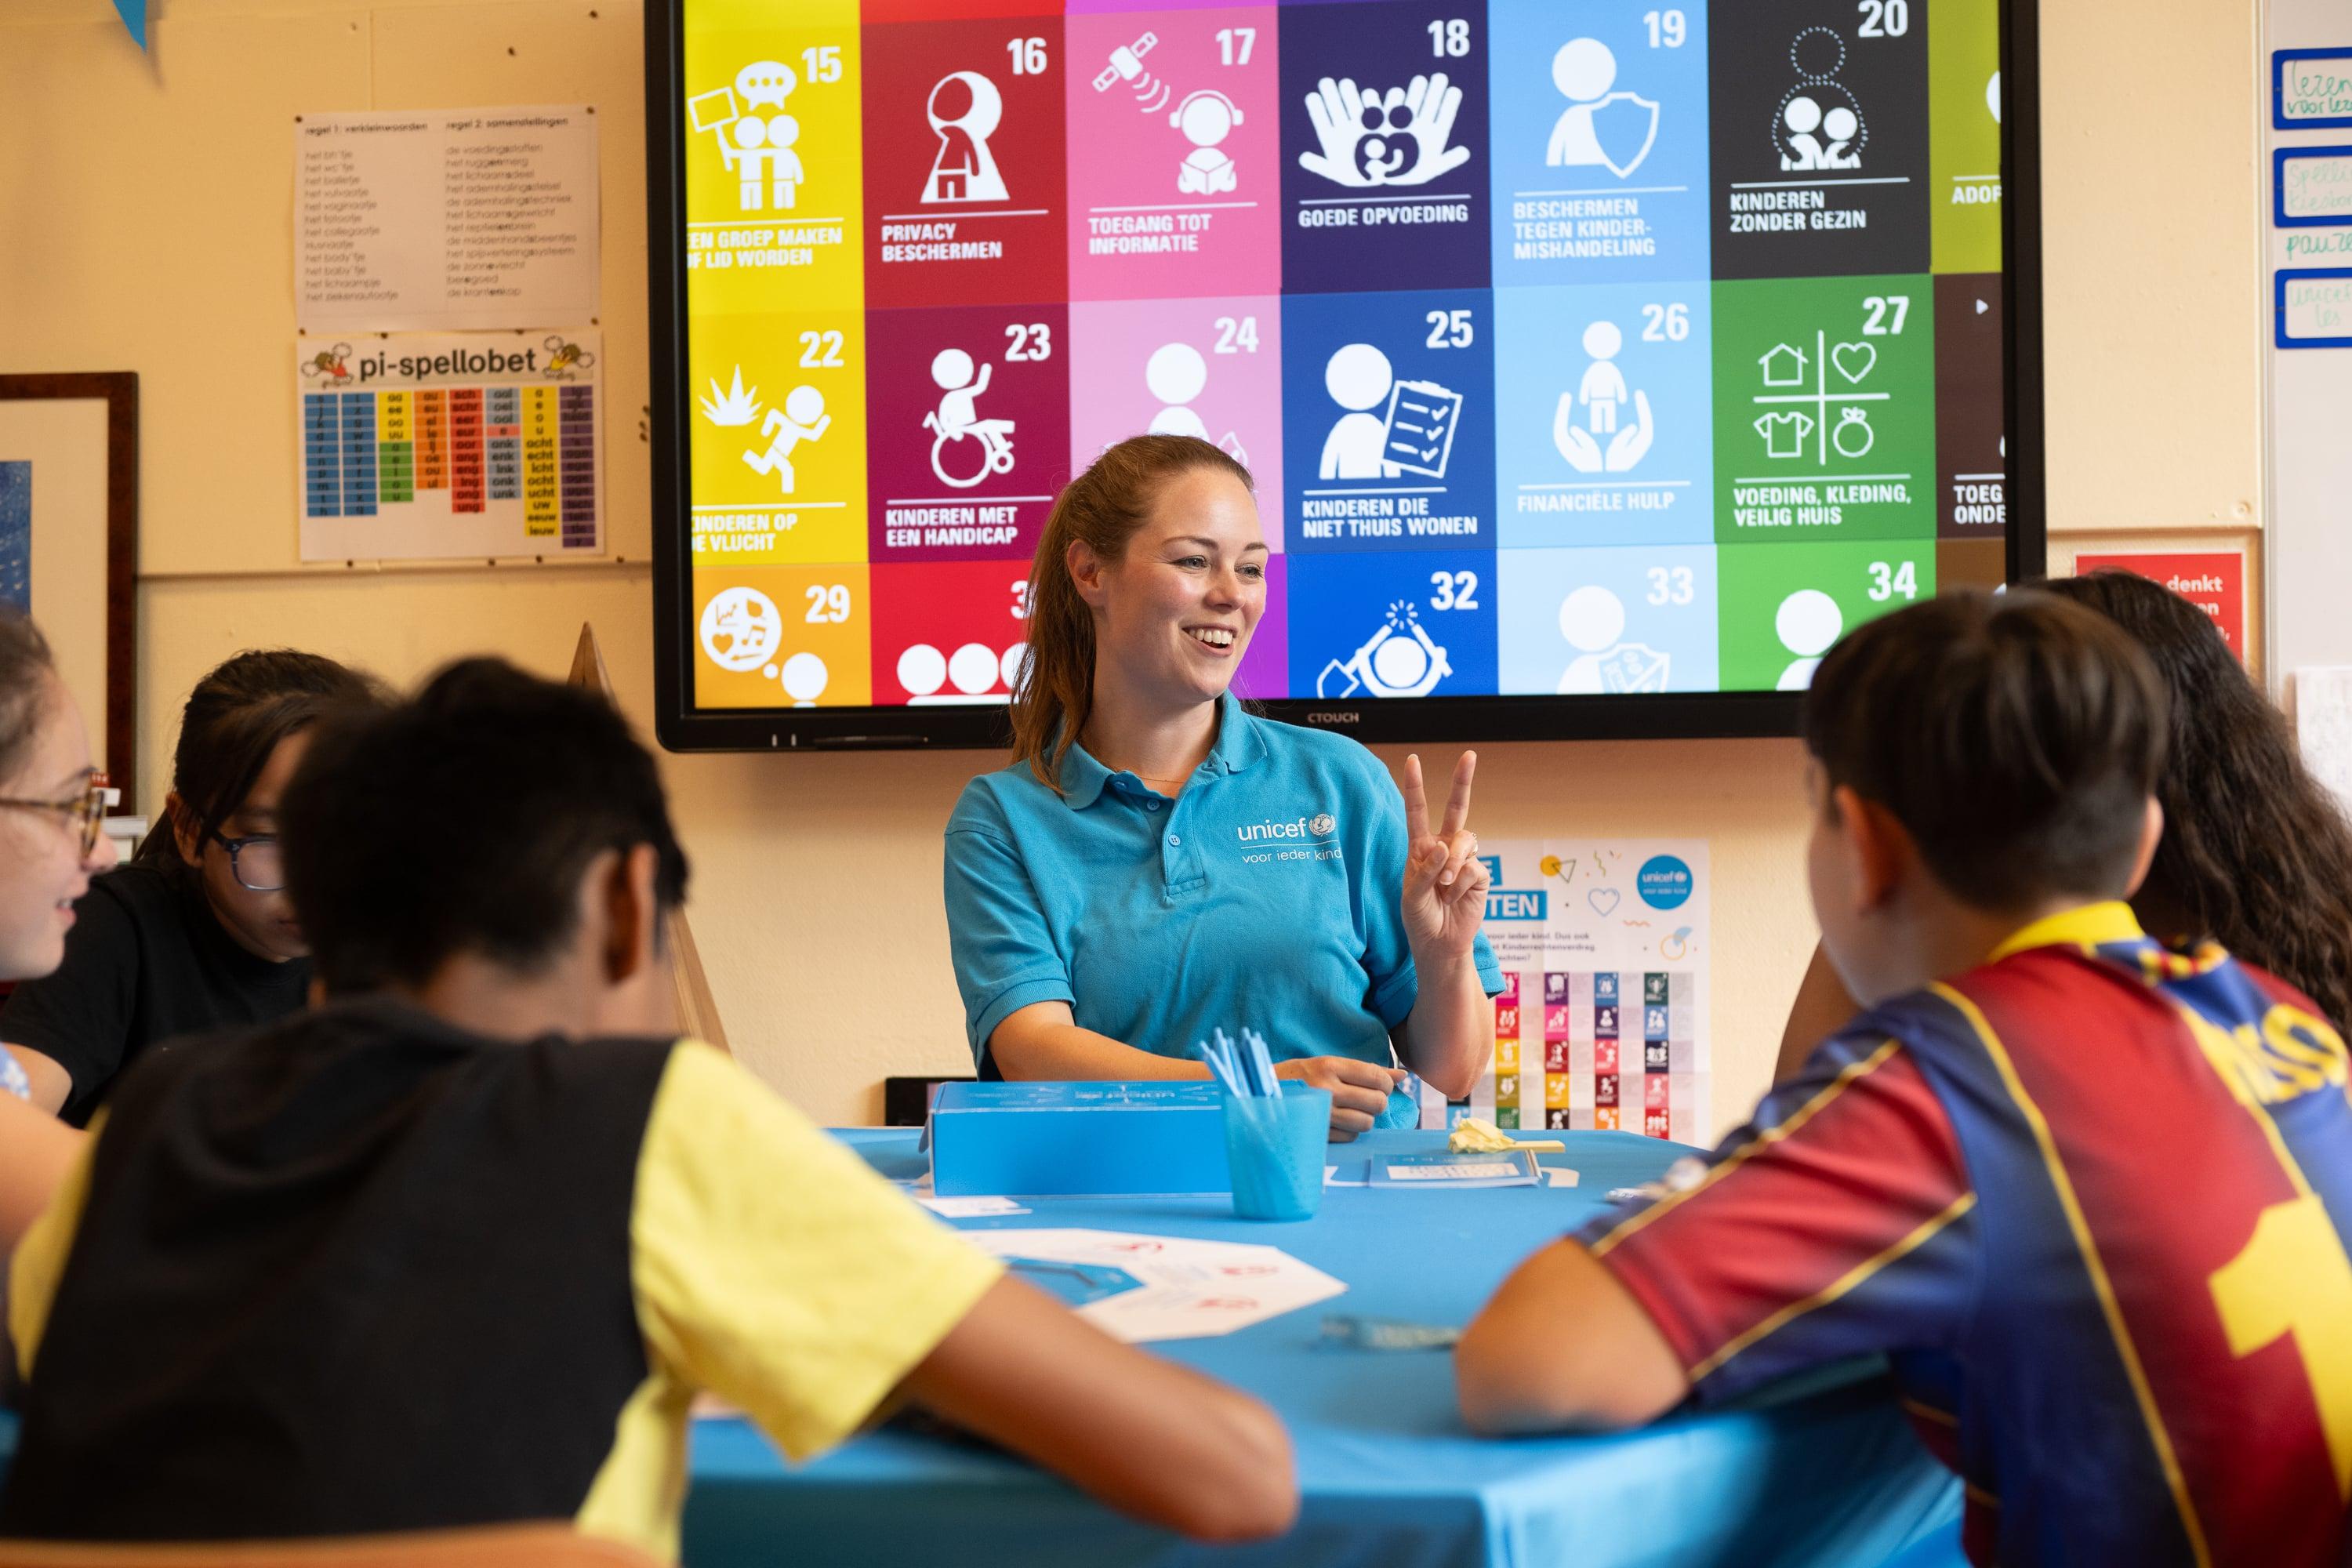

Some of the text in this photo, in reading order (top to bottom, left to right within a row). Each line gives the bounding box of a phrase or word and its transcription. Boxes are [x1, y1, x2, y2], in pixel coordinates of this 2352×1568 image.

[1643, 9, 1686, 48] 19
[1858, 0, 1908, 38] 20
[1215, 28, 1255, 65] 17
[1427, 19, 1470, 57] 18
[801, 45, 842, 83] 15
[1007, 37, 1047, 75] 16
[306, 125, 331, 136] regel
[446, 119, 473, 131] regel
[486, 116, 569, 129] samenstellingen
[1514, 198, 1638, 220] BESCHERMEN
[1730, 191, 1824, 212] KINDEREN
[1089, 214, 1211, 234] TOEGANG TOT
[1298, 205, 1468, 227] GOEDE OPVOEDING
[1730, 210, 1866, 232] ZONDER GEZIN
[687, 227, 842, 249] EN GROEP MAKEN
[882, 223, 956, 242] PRIVACY
[1513, 219, 1652, 240] TEGEN KINDER-
[882, 241, 1002, 263] BESCHERMEN
[1089, 234, 1198, 255] INFORMATIE
[1514, 238, 1655, 259] MISHANDELING
[706, 251, 732, 268] LID
[736, 249, 813, 267] WORDEN
[1642, 303, 1689, 342] 26
[1862, 296, 1910, 335] 27
[1214, 317, 1258, 354] 24
[1426, 310, 1473, 349] 25
[800, 330, 844, 368] 22
[1005, 323, 1051, 361] 23
[360, 347, 536, 381] pi-spellobet
[1518, 490, 1675, 513] FINANCIËLE HULP
[1733, 485, 1911, 507] VOEDING, KLEDING,
[1953, 484, 2003, 503] TOEG
[886, 506, 1018, 527] KINDEREN MET
[1303, 497, 1428, 518] KINDEREN DIE
[1734, 506, 1842, 526] VEILIG HUIS
[1955, 504, 2006, 524] ONDE
[691, 513, 797, 532] INDEREN OP
[1303, 517, 1477, 538] NIET THUIS WONEN
[710, 532, 775, 552] VLUCHT
[887, 526, 1018, 546] EEN HANDICAP
[1430, 571, 1479, 611] 32
[1646, 566, 1694, 606] 33
[1868, 561, 1917, 602] 34
[2166, 574, 2223, 593] denkt
[805, 584, 850, 623] 29
[1010, 580, 1038, 619] 3
[1307, 713, 1359, 724] CTOUCH
[1237, 817, 1307, 841] unicef
[1242, 847, 1342, 863] voor ieder kind
[1642, 870, 1674, 884] unicef
